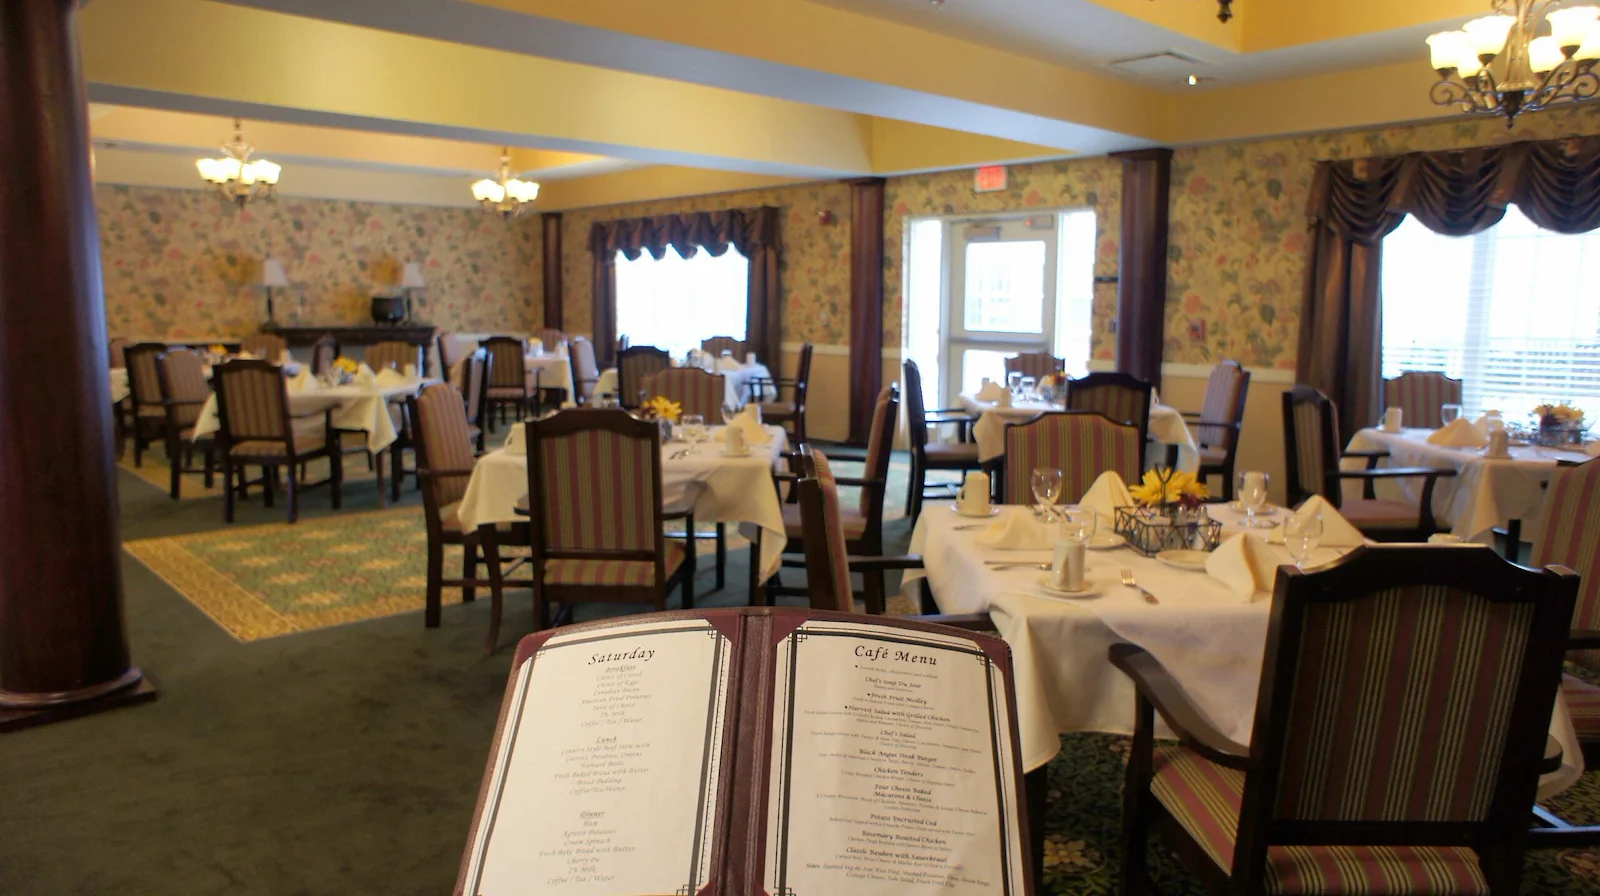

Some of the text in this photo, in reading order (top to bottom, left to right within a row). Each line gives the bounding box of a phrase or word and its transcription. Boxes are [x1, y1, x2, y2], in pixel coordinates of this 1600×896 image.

[588, 647, 654, 665] Saturday
[855, 645, 937, 666] Café Menu
[596, 736, 617, 744] Lunch
